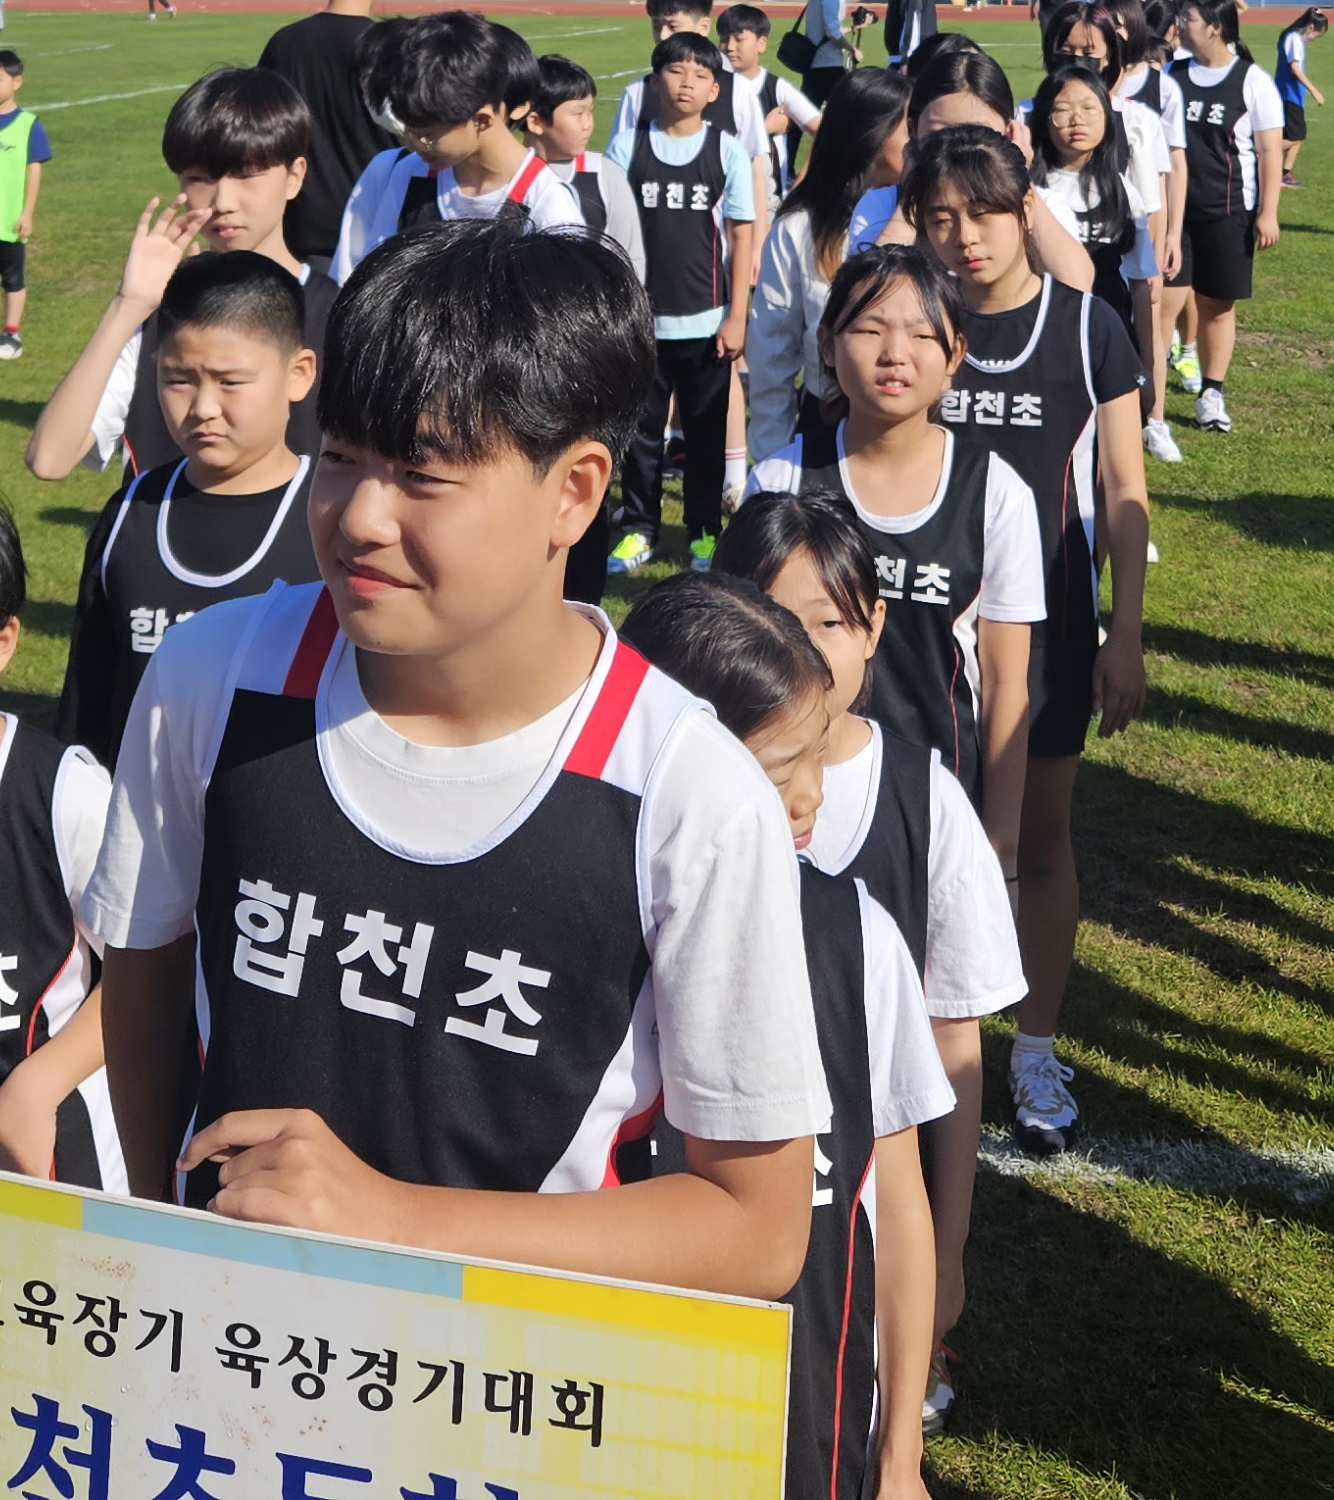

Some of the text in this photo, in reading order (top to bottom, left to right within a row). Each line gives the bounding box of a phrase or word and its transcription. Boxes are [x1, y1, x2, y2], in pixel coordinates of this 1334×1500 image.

[641, 181, 709, 211] 합천초
[940, 389, 1043, 427] 합천초
[232, 878, 553, 1056] 합천초
[215, 1322, 604, 1448] 육상경기대회
